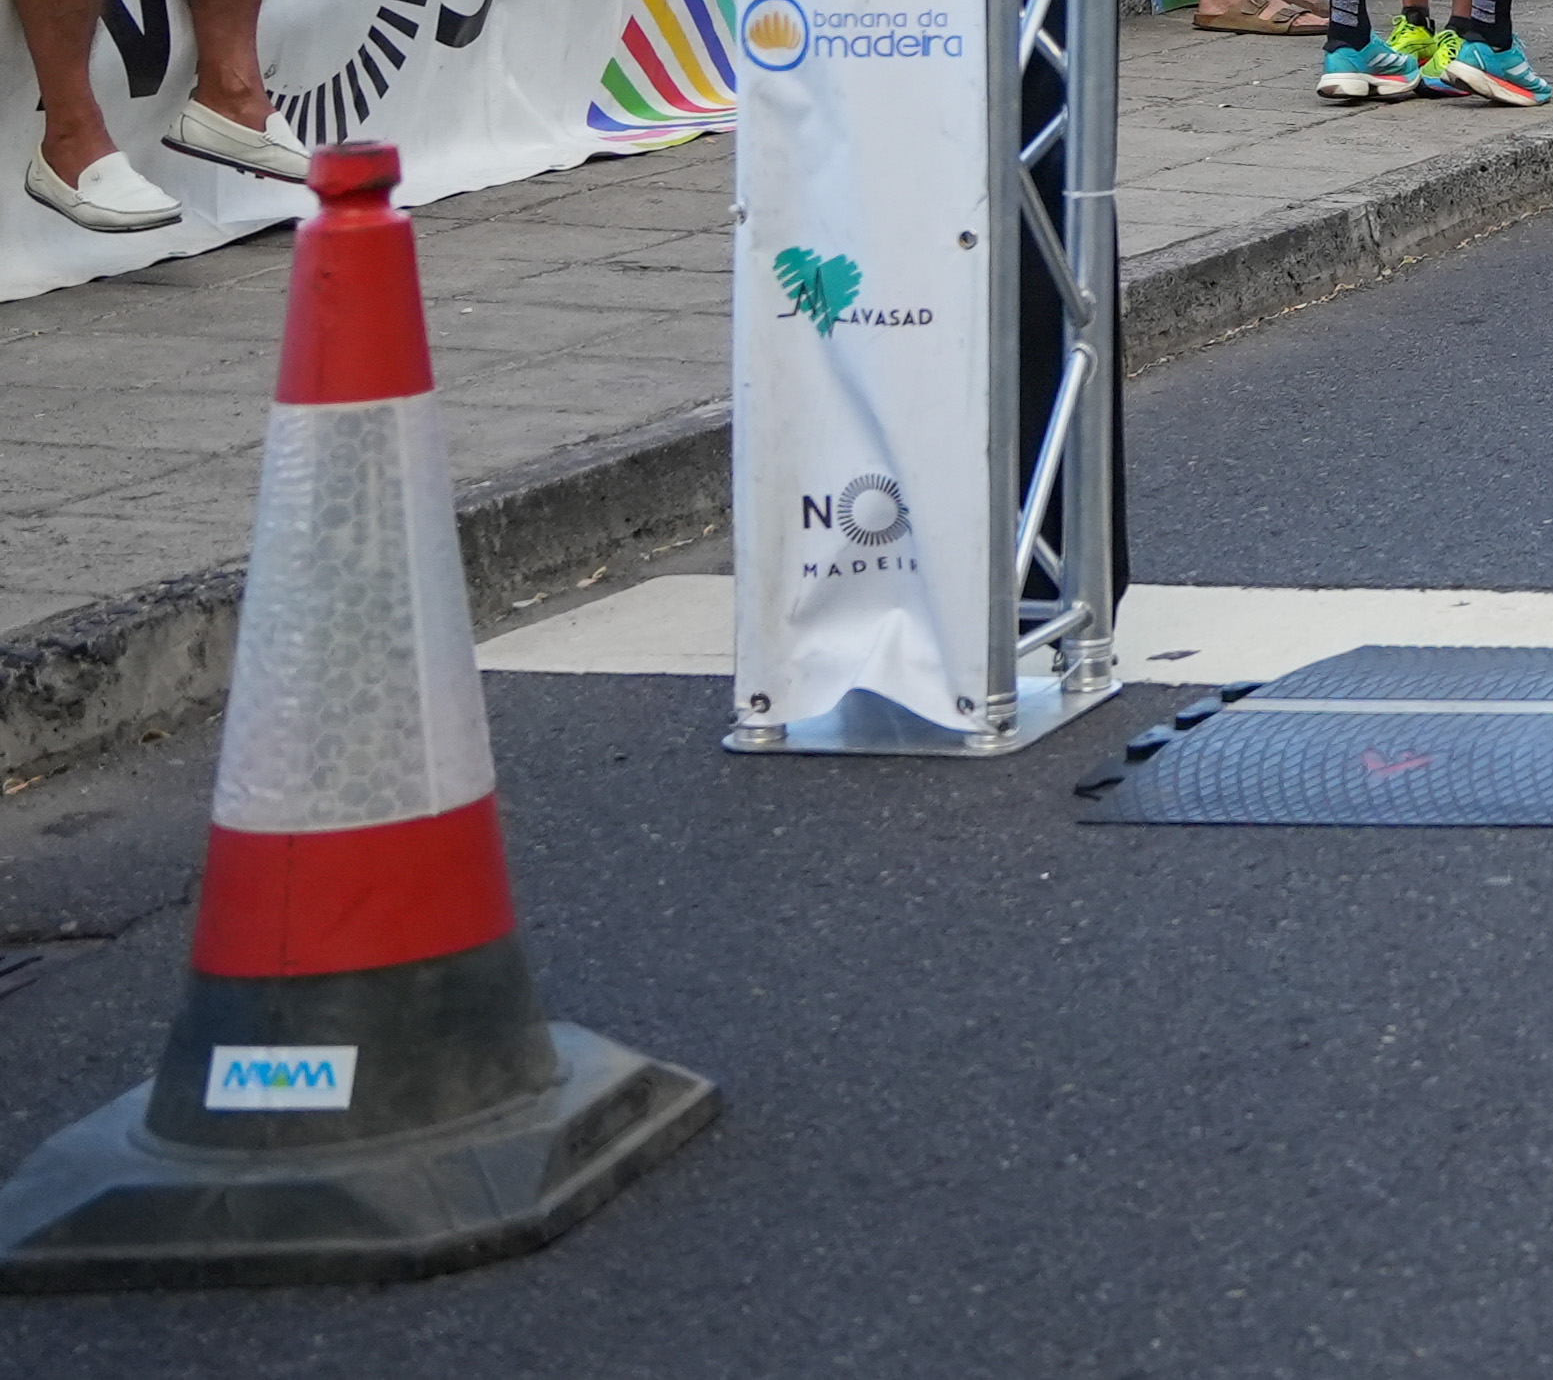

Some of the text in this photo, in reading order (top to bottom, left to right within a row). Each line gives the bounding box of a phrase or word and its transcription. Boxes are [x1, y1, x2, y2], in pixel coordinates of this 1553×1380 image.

[813, 9, 948, 28] banana da
[814, 29, 962, 57] madeira
